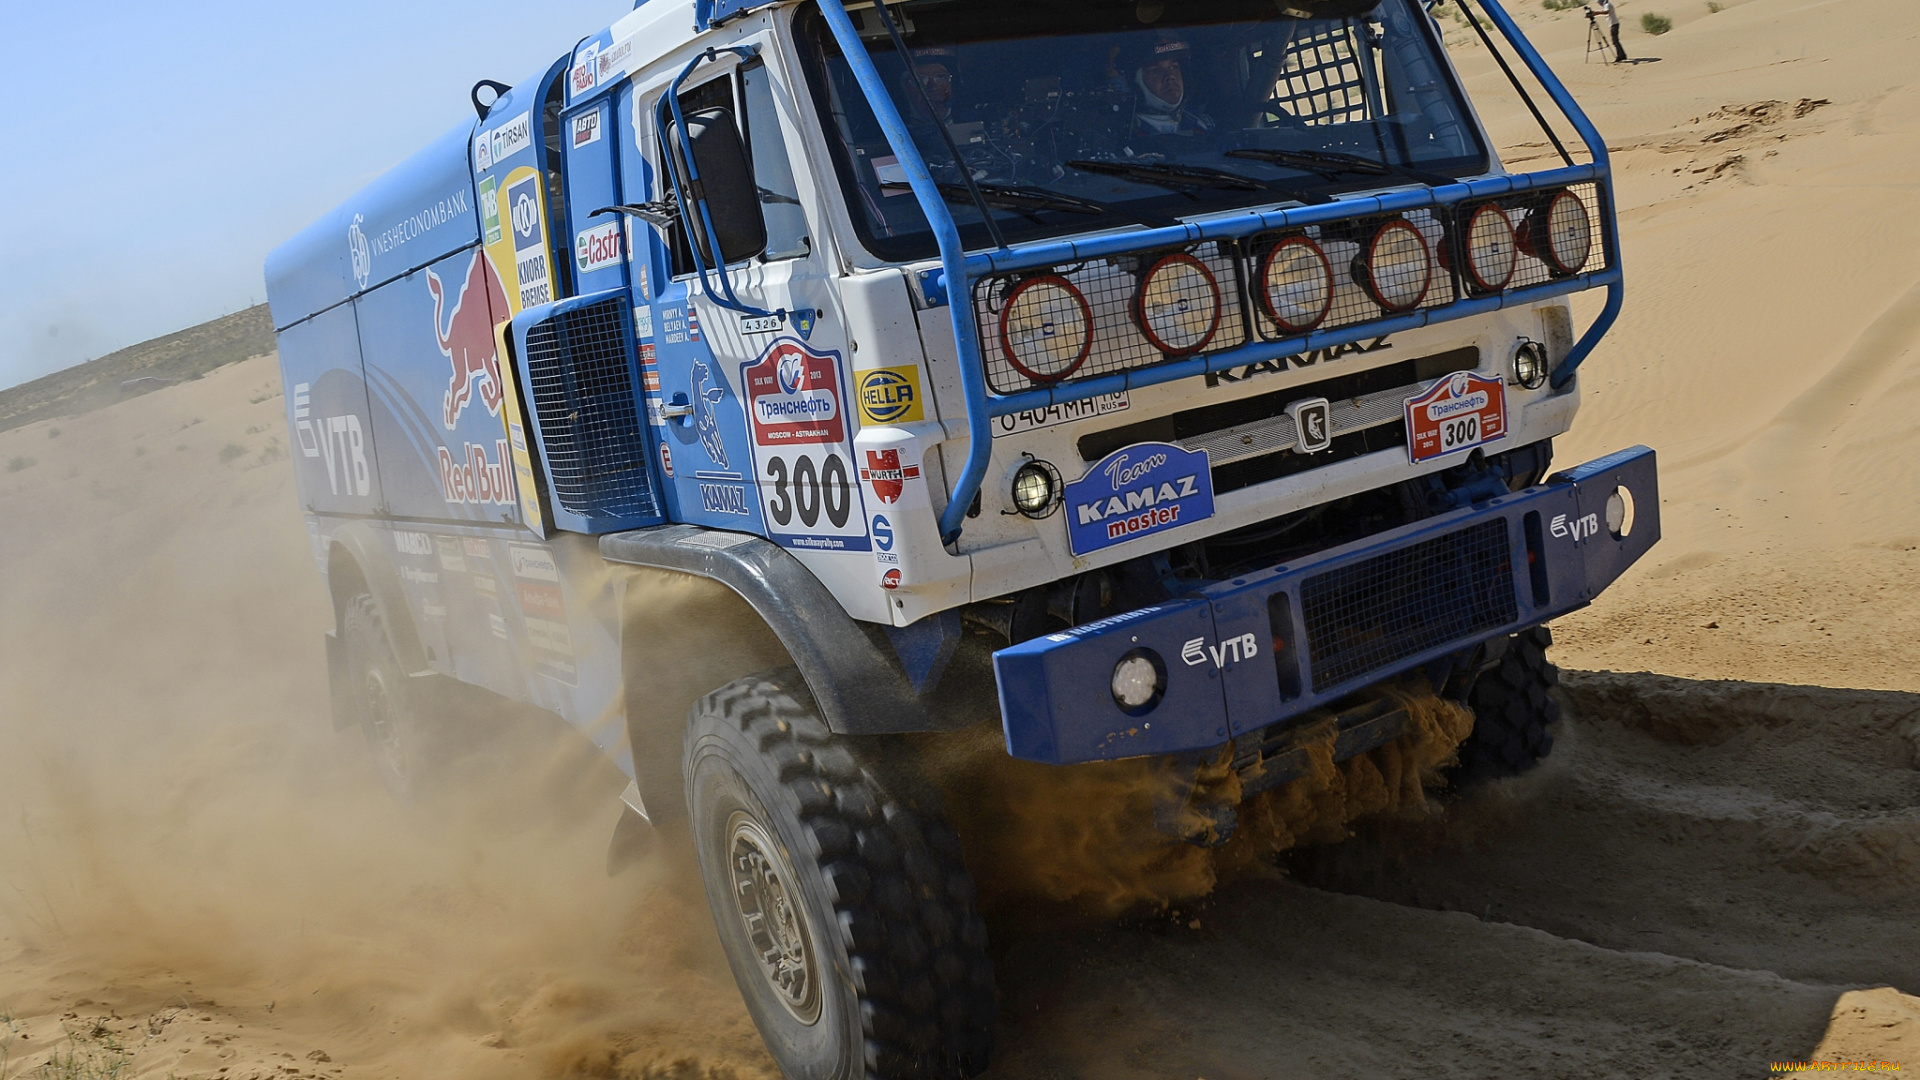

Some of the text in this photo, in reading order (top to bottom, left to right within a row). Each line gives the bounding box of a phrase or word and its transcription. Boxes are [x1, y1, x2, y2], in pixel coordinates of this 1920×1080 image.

[371, 189, 468, 257] VNESHECONOMBANK
[588, 224, 631, 265] Castrl
[517, 255, 547, 286] KNORR
[521, 284, 550, 309] BREMSE
[745, 319, 778, 332] 4326
[810, 371, 822, 380] 2013
[758, 397, 831, 419] Транснефть
[863, 384, 913, 405] HELLA
[1101, 402, 1117, 411] RUS
[1432, 395, 1485, 417] Транснефть
[767, 429, 829, 439] MOSCOW ASTRAKHAN
[1445, 417, 1477, 447] 300
[317, 414, 370, 497] VTB
[662, 449, 673, 472] E
[1104, 453, 1167, 491] Team
[699, 483, 750, 516] KAMAZ
[767, 453, 851, 529] 300
[1077, 475, 1200, 525] KAMAZ
[1107, 504, 1180, 539] master
[1569, 513, 1599, 542] VTB
[393, 531, 433, 555] WABCO
[1208, 632, 1258, 669] VTB
